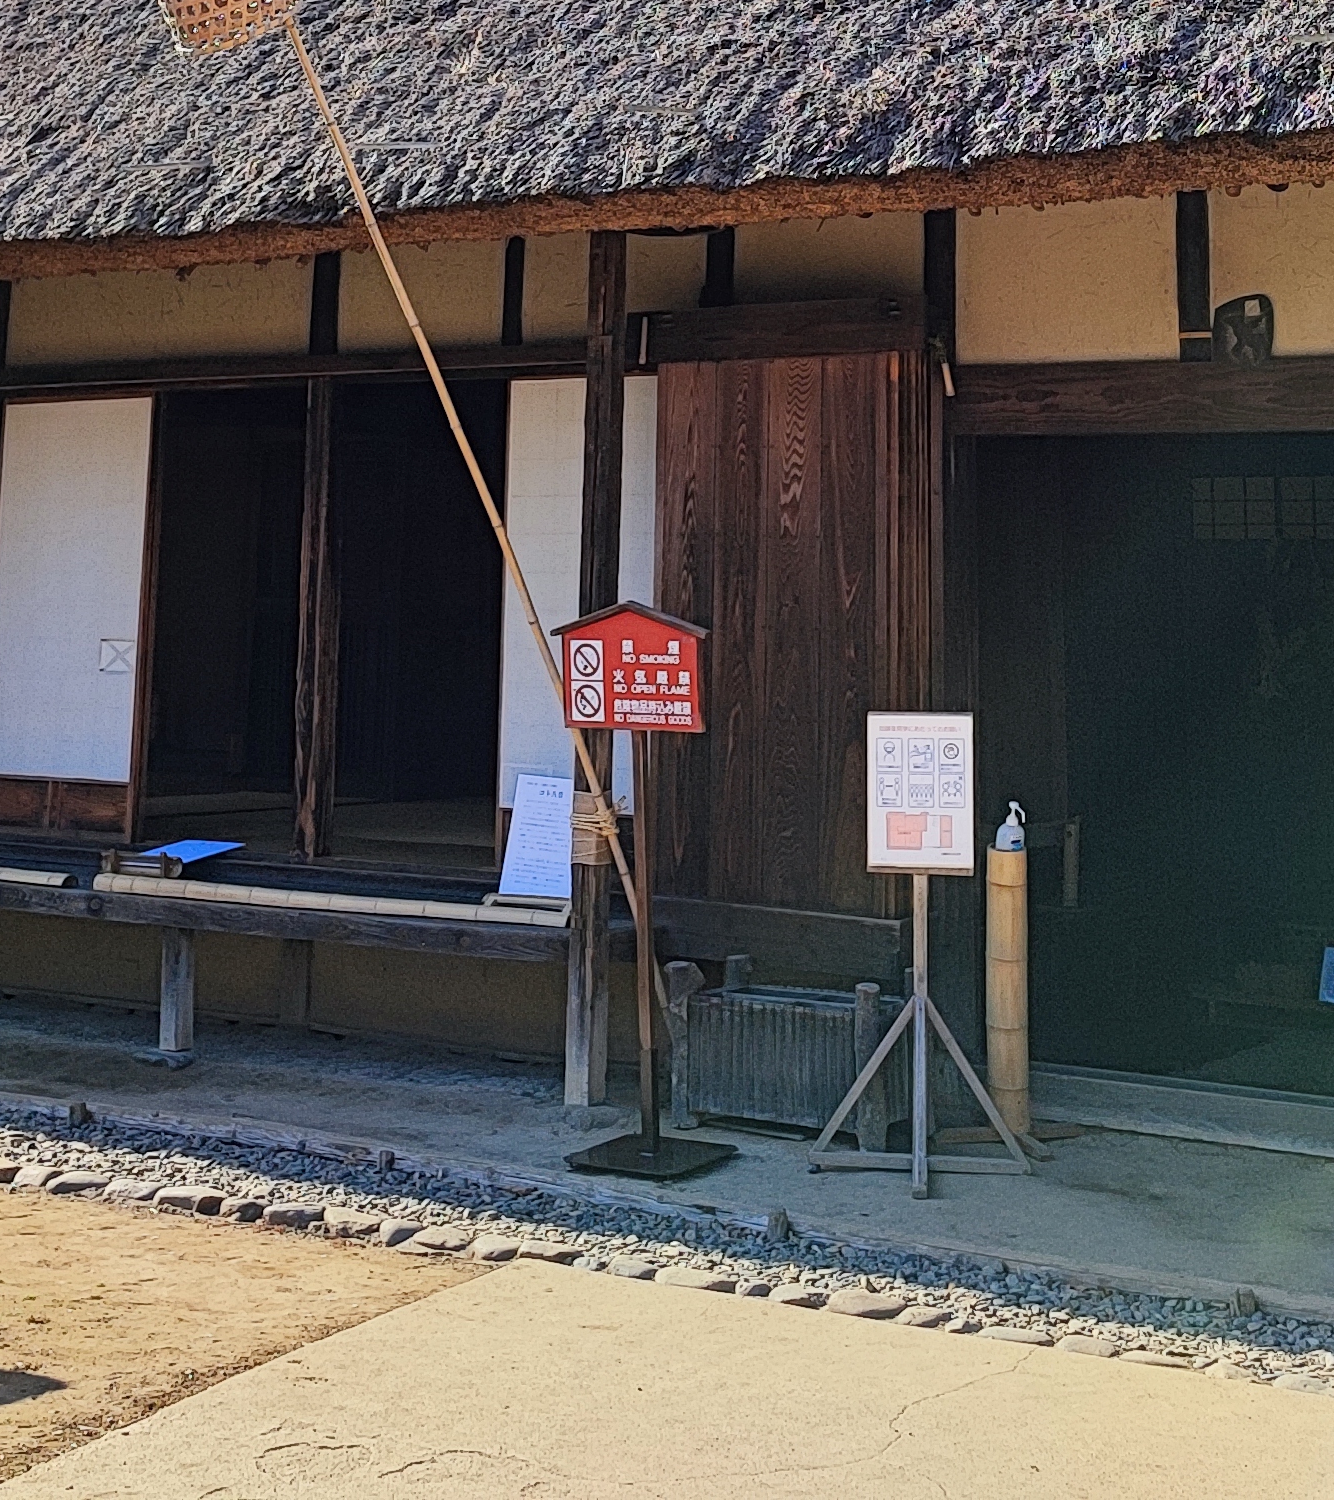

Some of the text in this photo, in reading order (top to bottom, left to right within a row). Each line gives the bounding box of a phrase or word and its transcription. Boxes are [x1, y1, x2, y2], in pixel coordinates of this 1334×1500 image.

[621, 654, 680, 664] NO SMOKING
[613, 683, 691, 696] NO OPEN FLAME
